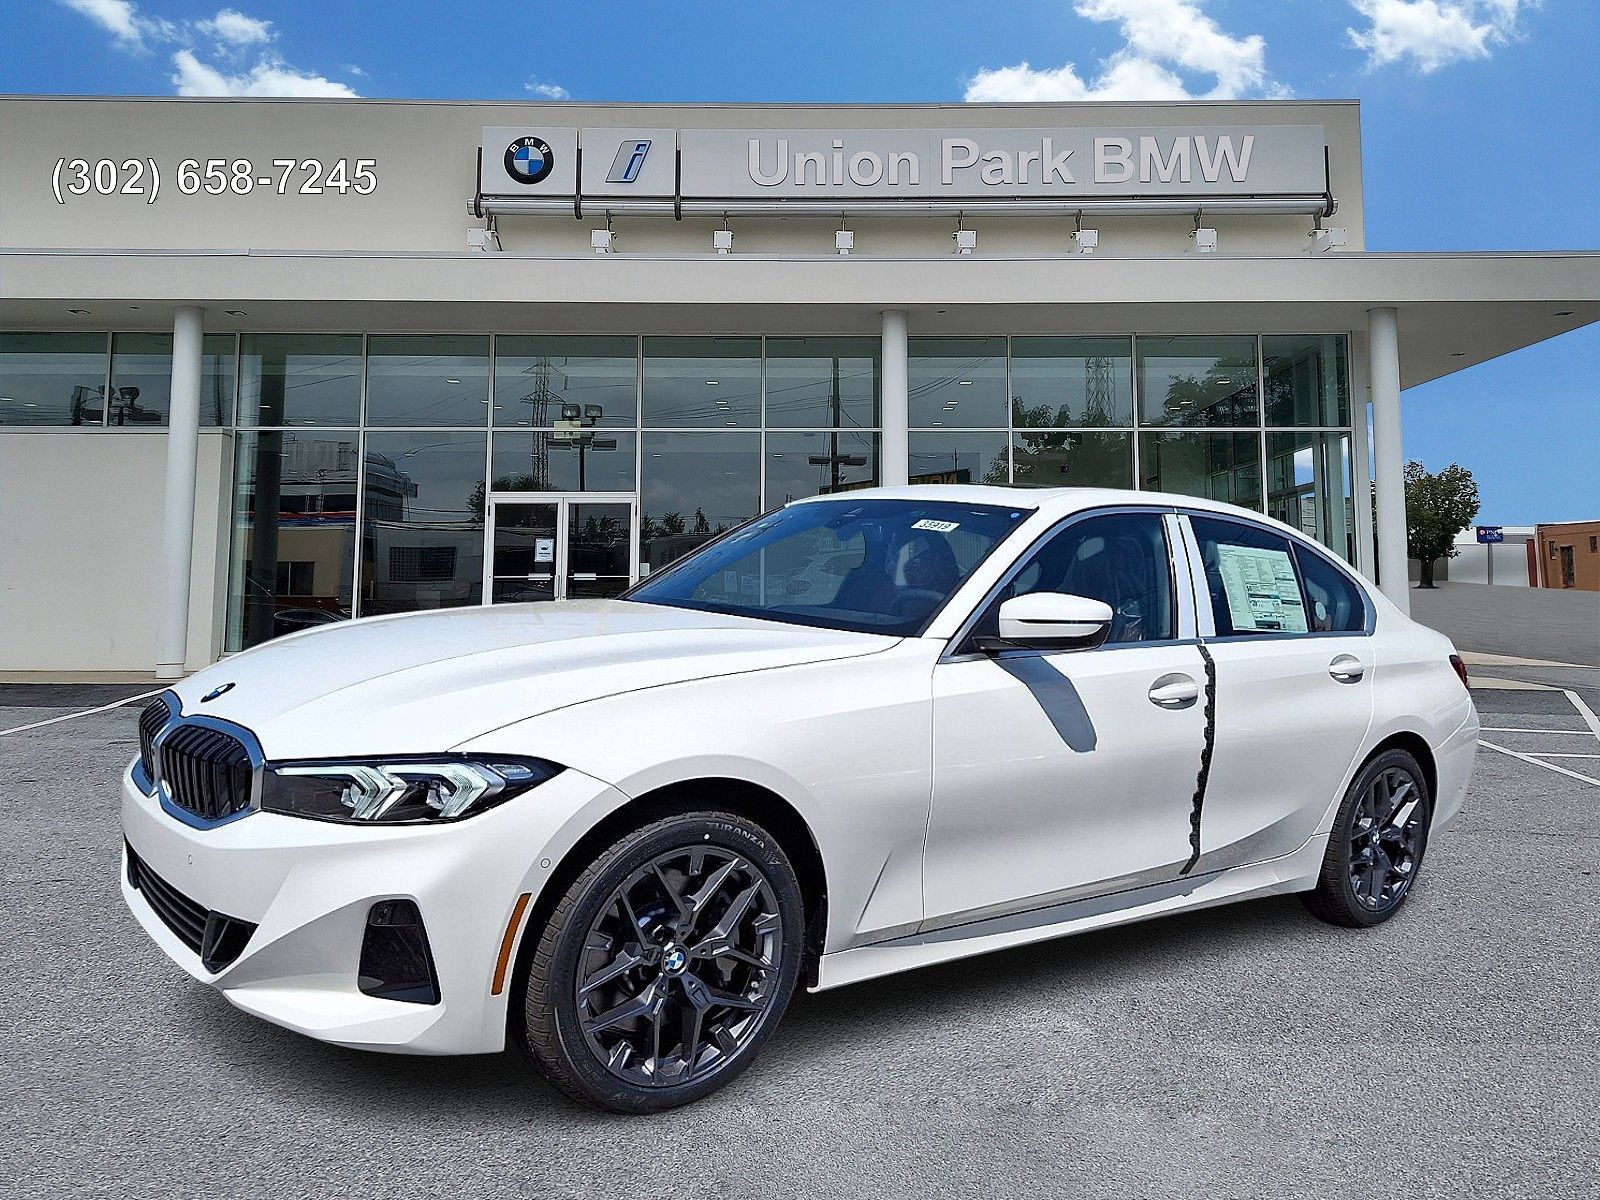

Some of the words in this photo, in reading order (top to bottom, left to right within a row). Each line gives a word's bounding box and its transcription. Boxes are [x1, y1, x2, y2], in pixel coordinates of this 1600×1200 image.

[509, 138, 550, 154] BMW
[746, 138, 921, 187] Union
[940, 137, 1077, 186] Park
[1093, 134, 1256, 184] BMW
[919, 520, 952, 530] 35919
[706, 821, 765, 849] TURANZA
